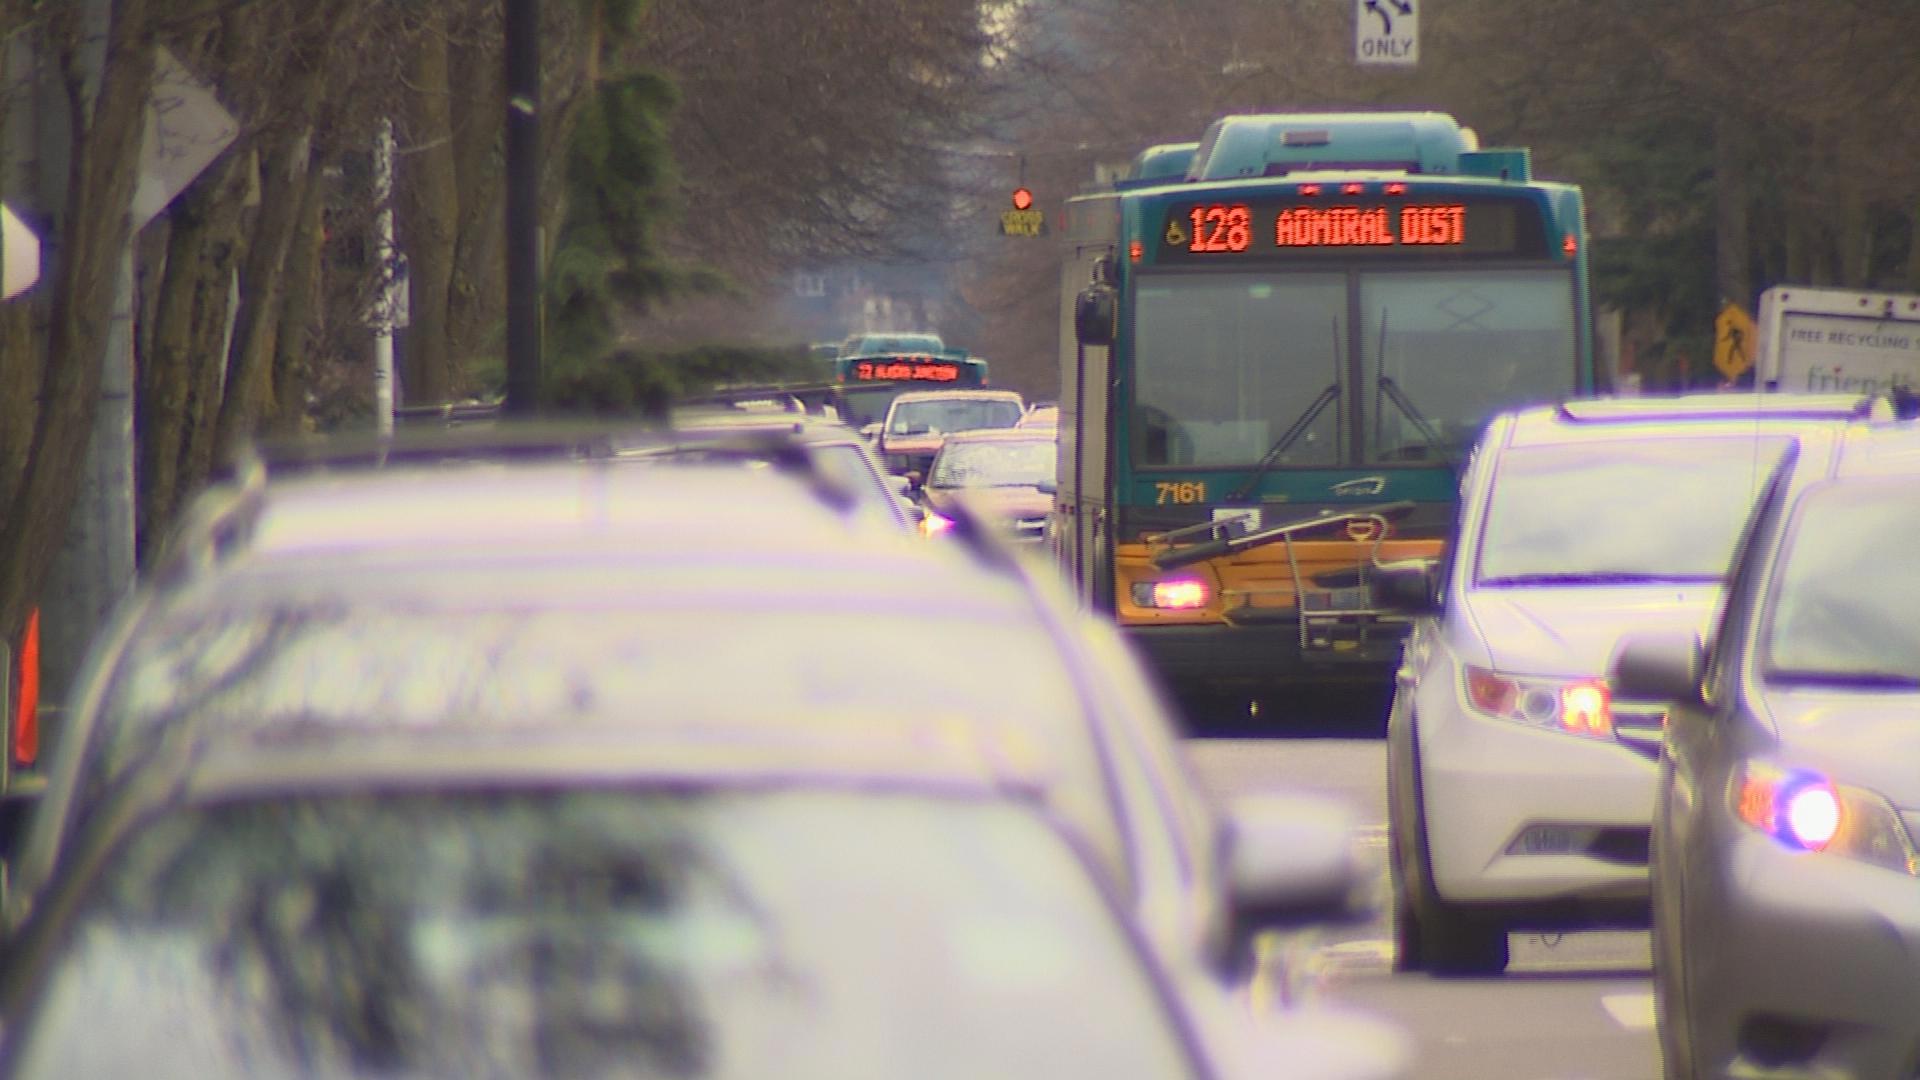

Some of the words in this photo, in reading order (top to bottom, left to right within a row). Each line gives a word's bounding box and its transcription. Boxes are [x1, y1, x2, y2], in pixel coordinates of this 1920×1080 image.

[1361, 37, 1413, 57] ONLY
[1189, 204, 1251, 252] 128
[1275, 206, 1395, 247] ADMIRAL
[1400, 205, 1466, 245] DIST
[1791, 328, 1825, 344] FREE
[1828, 331, 1910, 350] RECYCLING
[1155, 482, 1205, 504] 7161
